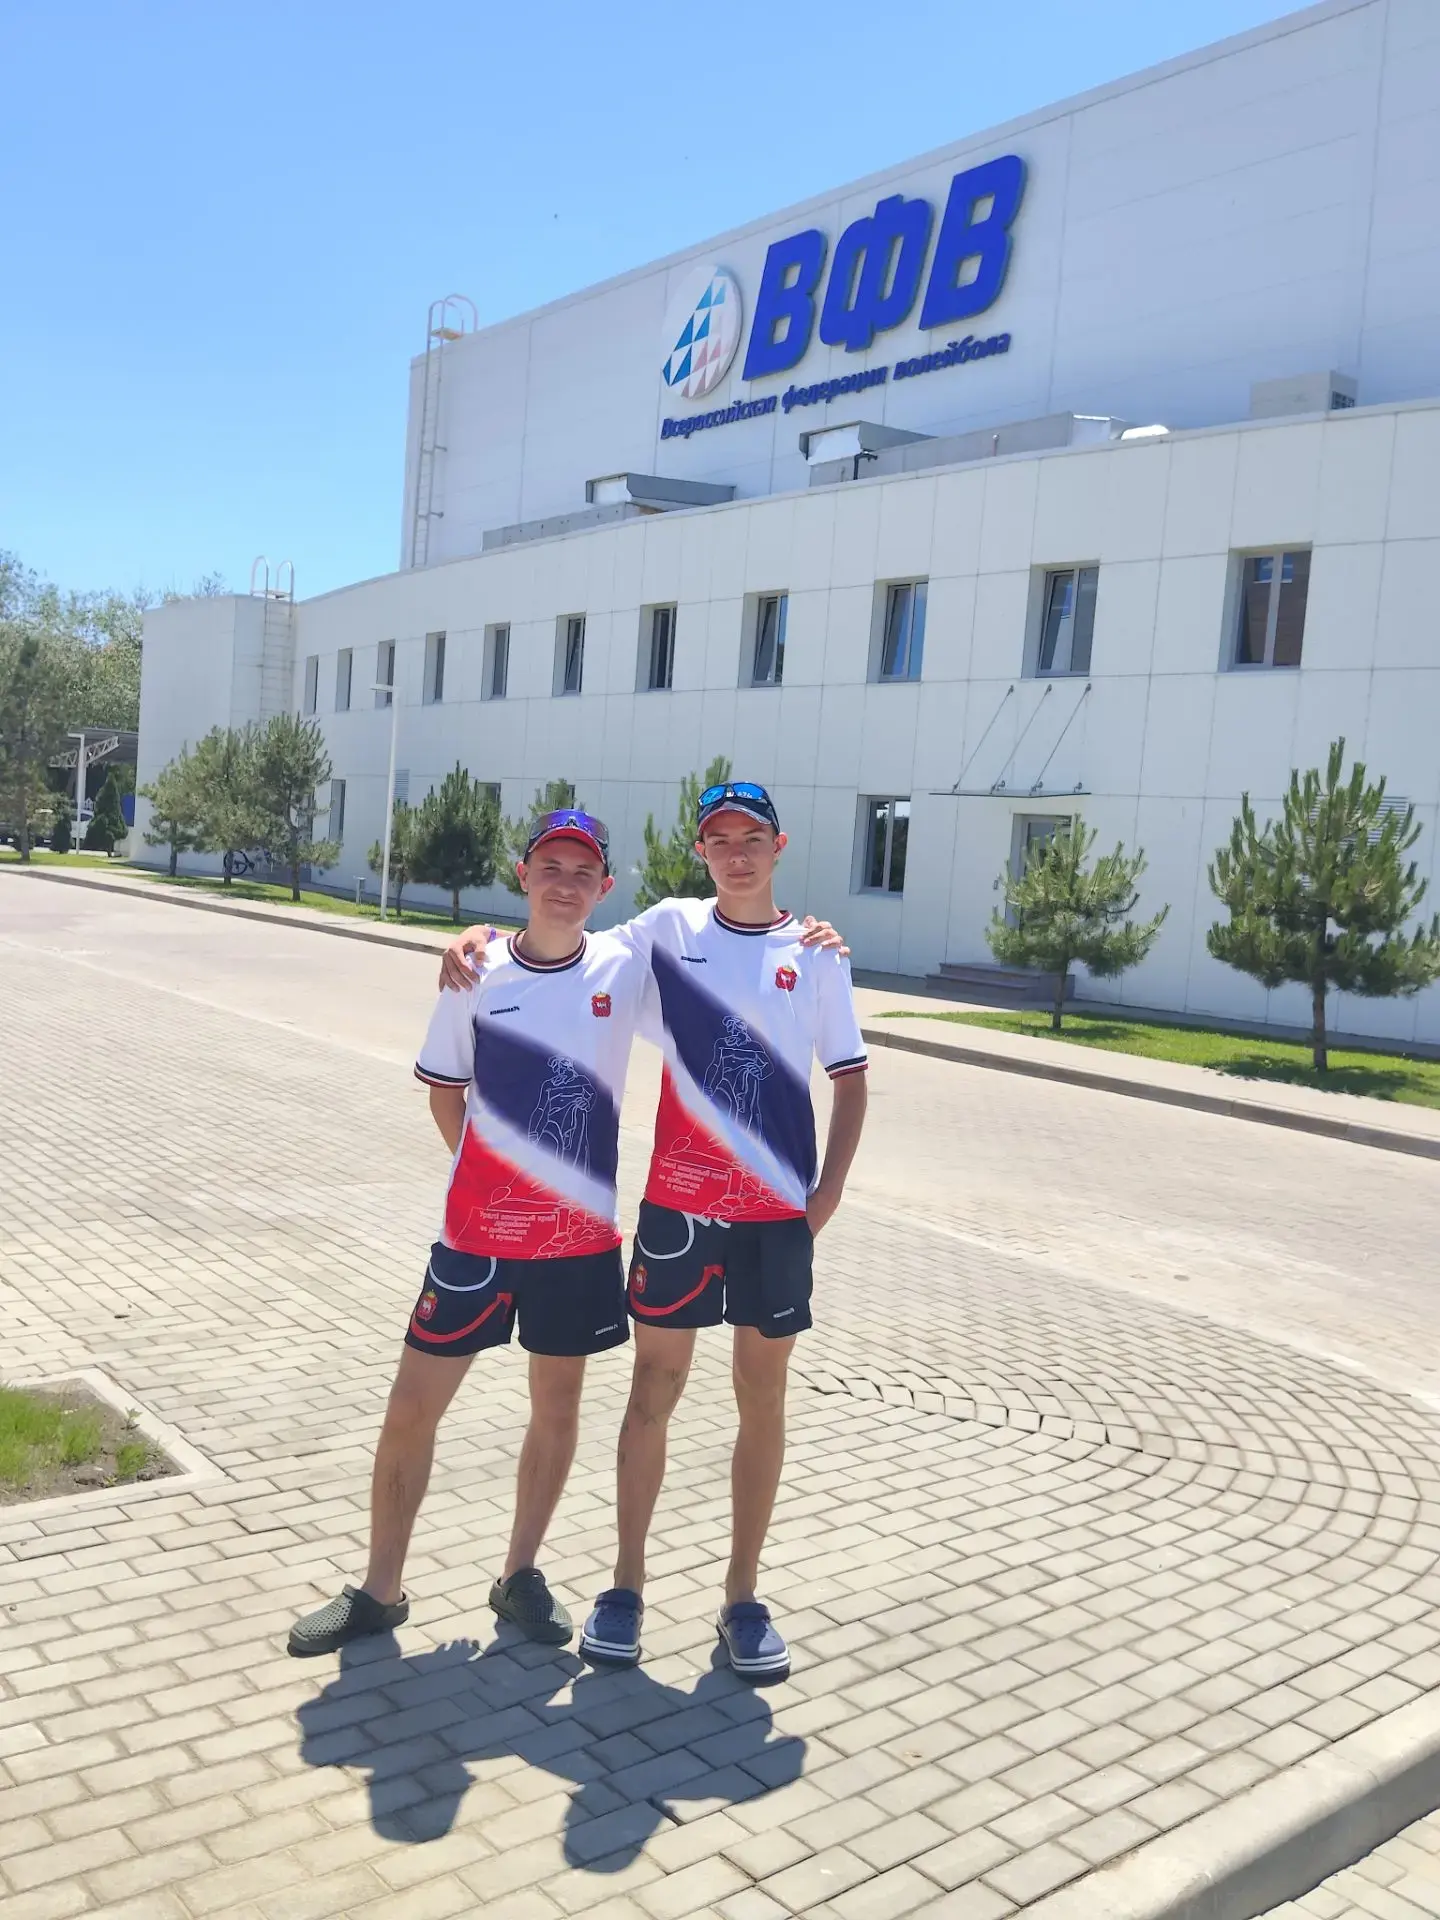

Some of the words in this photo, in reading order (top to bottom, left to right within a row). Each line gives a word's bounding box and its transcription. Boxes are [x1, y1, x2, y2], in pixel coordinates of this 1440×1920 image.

[742, 155, 1028, 381] ВФВ
[661, 395, 777, 440] Всероссийская
[781, 366, 888, 414] федерации
[892, 332, 1011, 380] волейбола
